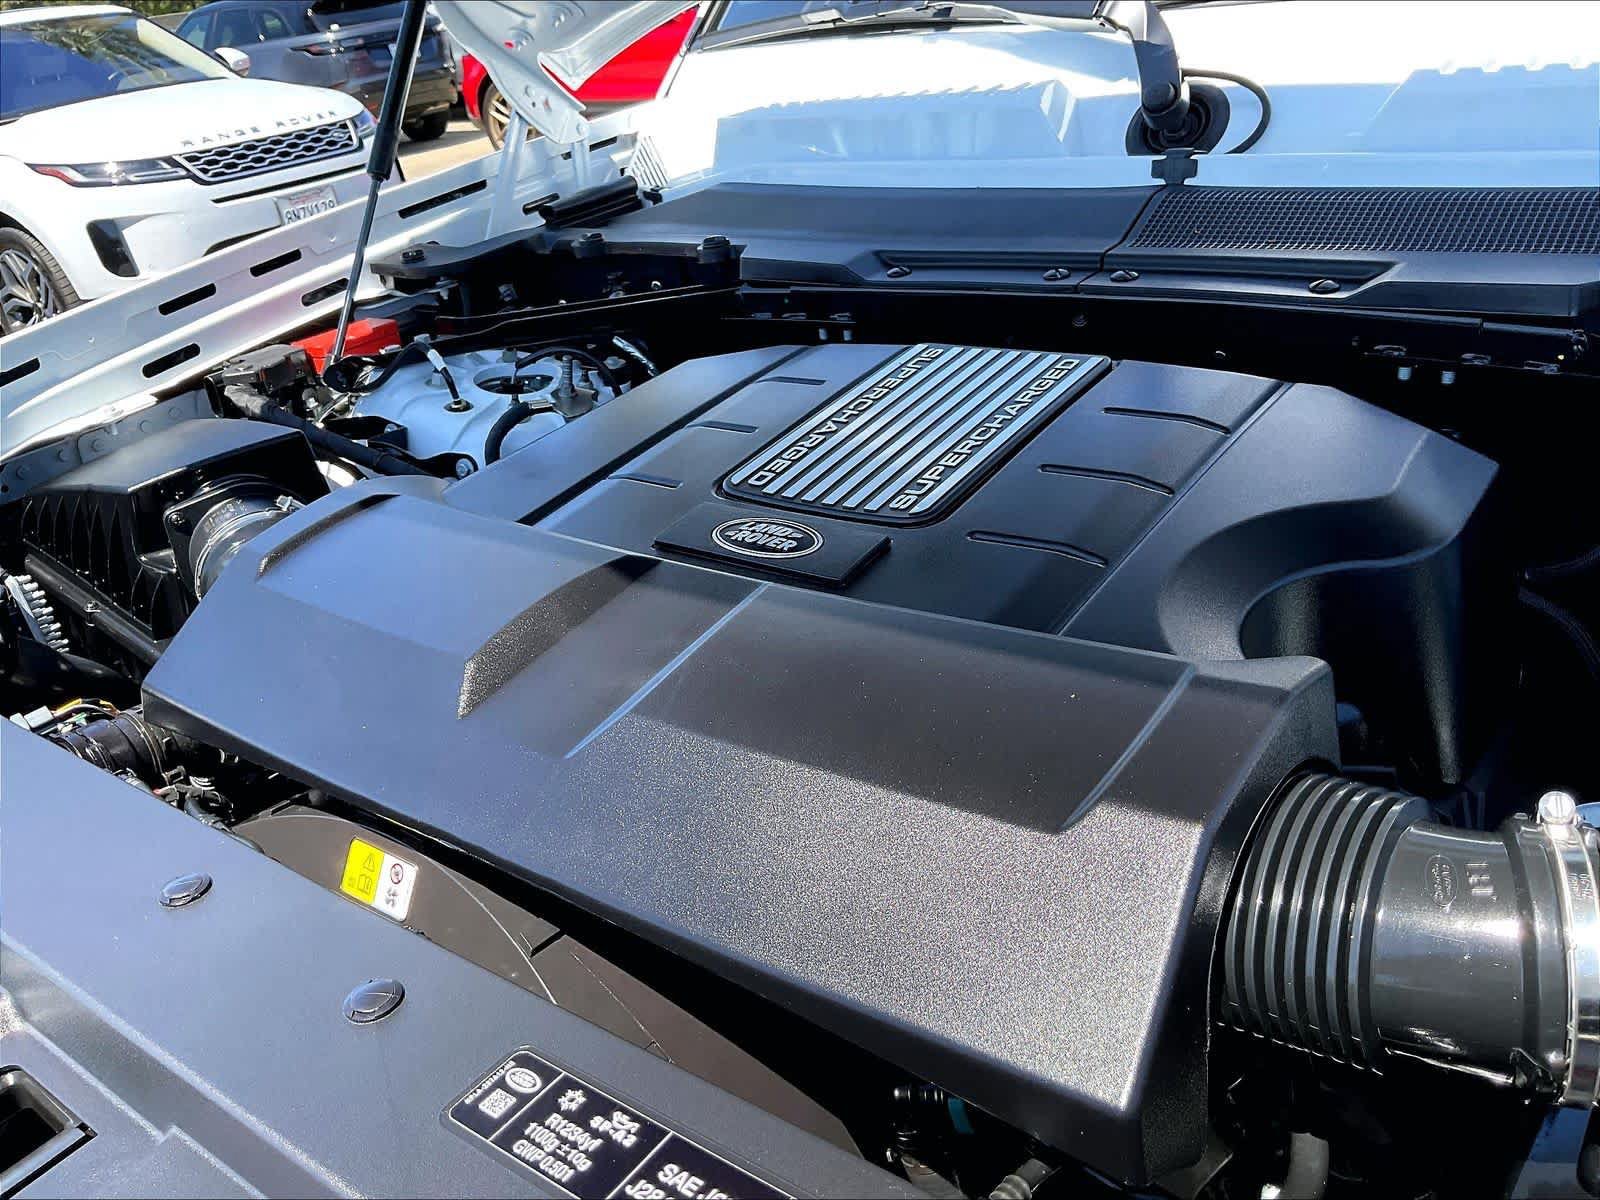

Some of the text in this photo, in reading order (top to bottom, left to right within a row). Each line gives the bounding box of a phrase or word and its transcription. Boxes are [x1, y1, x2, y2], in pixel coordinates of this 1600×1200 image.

[275, 110, 337, 128] ROVER
[748, 349, 944, 486] SUPERCHARGED
[889, 358, 1080, 510] SUPERCHARGED
[730, 530, 798, 551] ROVER
[739, 521, 794, 537] LAND
[544, 1112, 604, 1153] R1234yf
[512, 1139, 547, 1163] GWP
[657, 1163, 705, 1198] SAE
